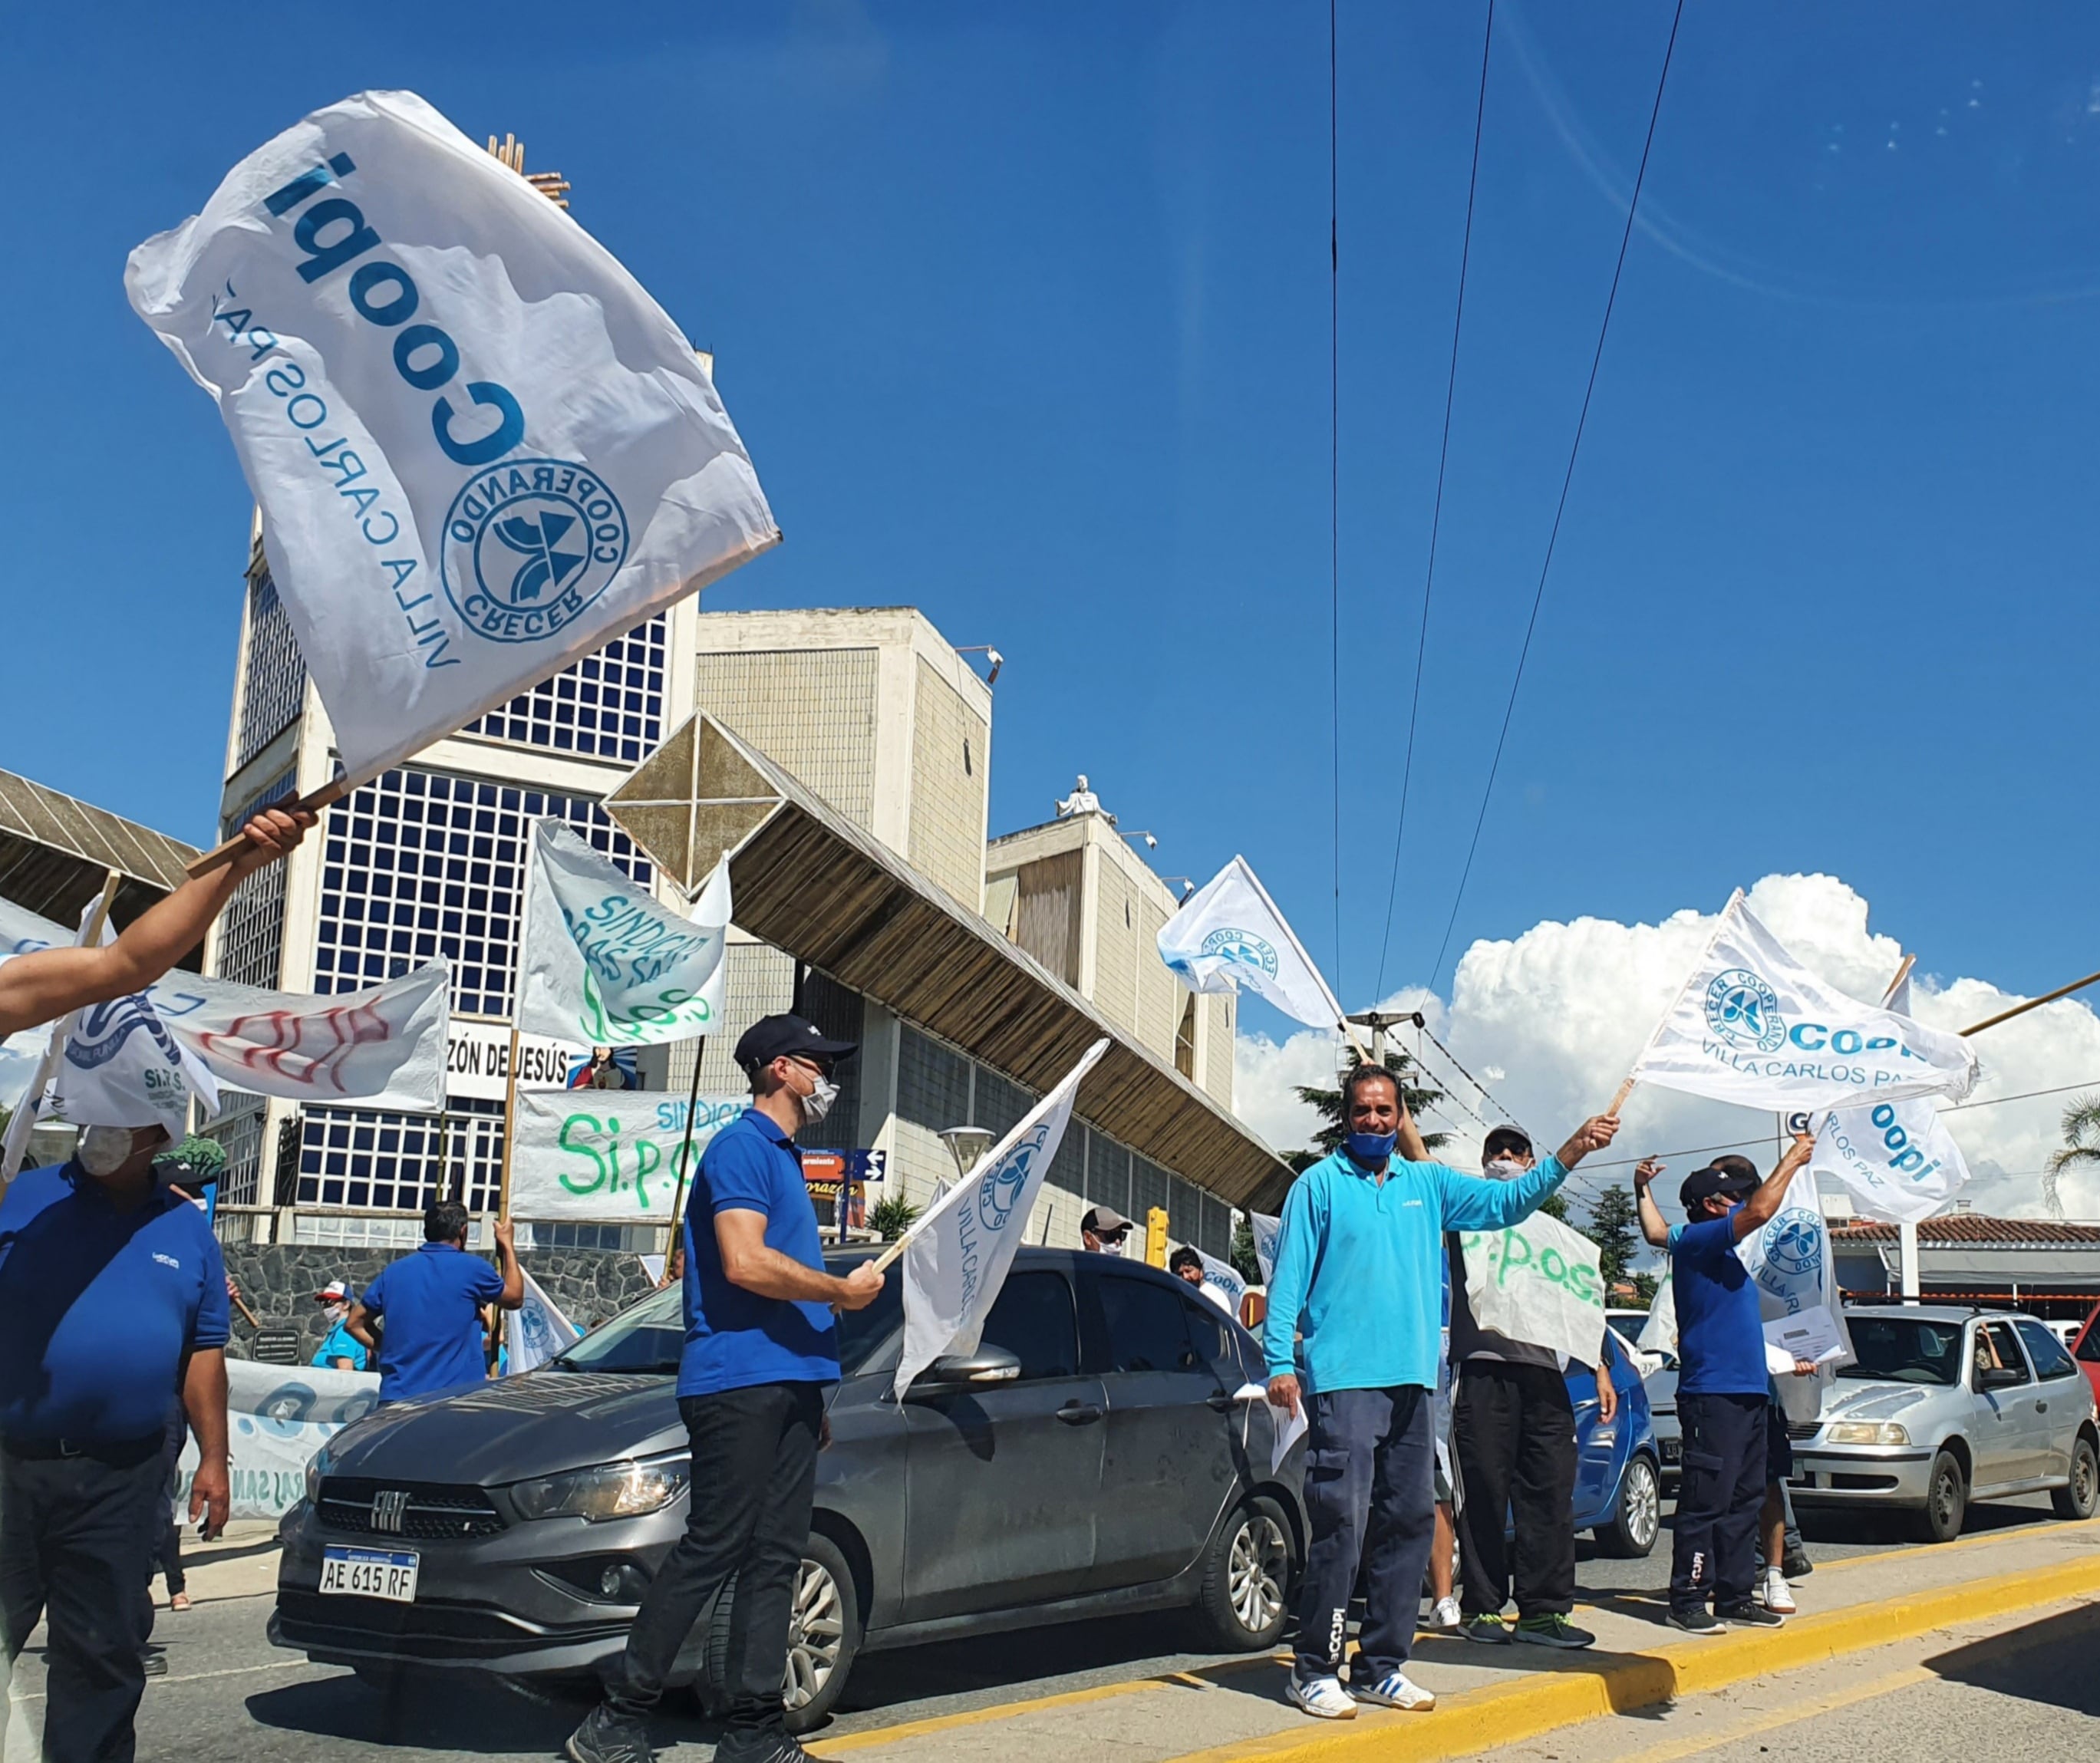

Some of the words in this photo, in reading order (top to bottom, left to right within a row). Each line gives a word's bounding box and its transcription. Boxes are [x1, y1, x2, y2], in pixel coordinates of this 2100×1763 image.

[1709, 979, 1736, 1041] CRECER
[1738, 973, 1782, 1051] COOPERANDO
[486, 1043, 509, 1078] DE
[515, 1042, 567, 1084] JESÚS
[1703, 1037, 1759, 1076] VILLA
[1765, 1061, 1865, 1084] CARLOS
[1874, 1070, 1916, 1087] PA
[1828, 1112, 1856, 1162] RLOS
[1854, 1161, 1885, 1189] PAZ
[1871, 1103, 1941, 1182] oopi
[958, 1197, 978, 1258] VILLA
[1765, 1216, 1787, 1264] CRECER
[1750, 1259, 1786, 1297] VILLA
[1641, 1364, 1653, 1374] 37
[324, 1562, 345, 1589] AE
[352, 1566, 383, 1593] 615
[387, 1568, 410, 1597] RF
